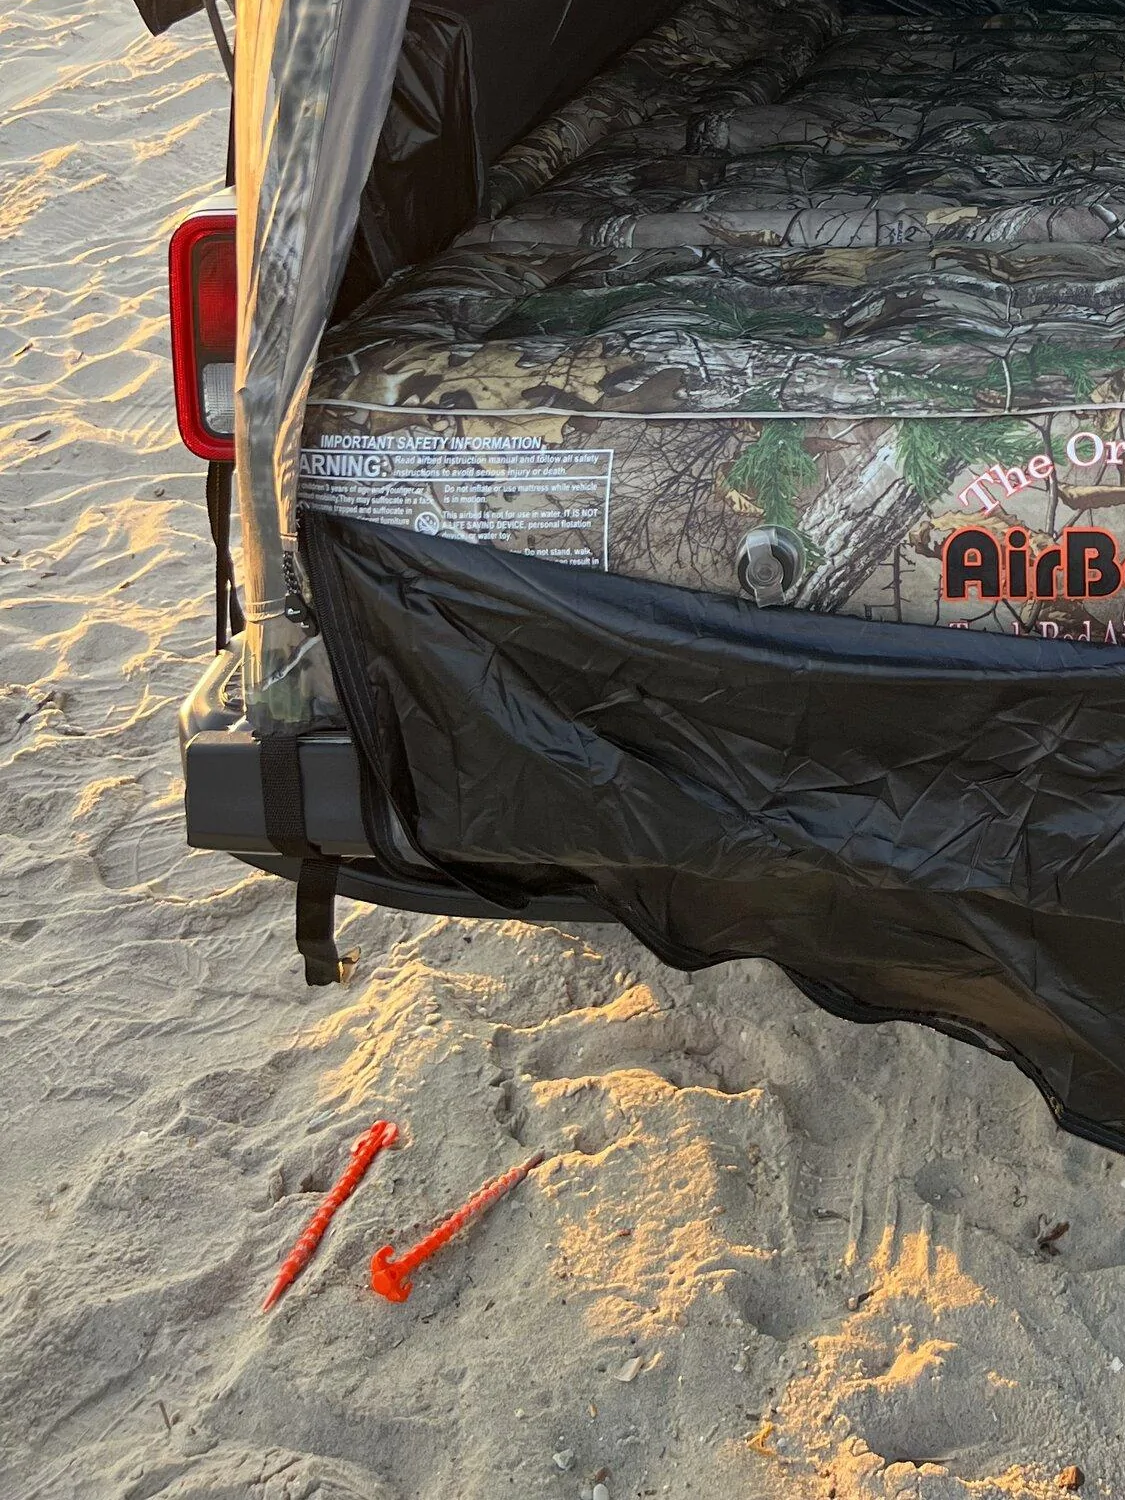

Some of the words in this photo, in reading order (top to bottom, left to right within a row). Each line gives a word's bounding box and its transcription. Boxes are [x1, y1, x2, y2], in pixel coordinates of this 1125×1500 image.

[321, 435, 395, 449] IMPORTANT
[397, 436, 449, 450] SAFETY
[450, 436, 542, 450] INFORMATION
[394, 456, 415, 465] Read
[443, 455, 487, 464] instruction
[488, 455, 518, 464] manual
[519, 455, 535, 464] and
[537, 454, 560, 463] follow
[574, 454, 599, 465] safety
[299, 454, 388, 477] ARNING:
[393, 467, 441, 477] instructions
[443, 468, 450, 476] to
[451, 467, 473, 476] avoid
[475, 467, 506, 476] serious
[507, 467, 531, 478] injury
[444, 484, 453, 492] Do
[518, 484, 550, 492] mattress
[551, 483, 570, 491] while
[571, 483, 598, 491] vehicle
[958, 454, 1054, 515] The
[371, 496, 403, 504] suffocate
[373, 506, 404, 514] suffocate
[443, 510, 458, 518] This
[571, 509, 580, 517] IS
[581, 509, 599, 517] NOT
[466, 521, 495, 529] SAVING
[528, 520, 560, 530] personal
[525, 548, 535, 556] Do
[536, 548, 549, 556] not
